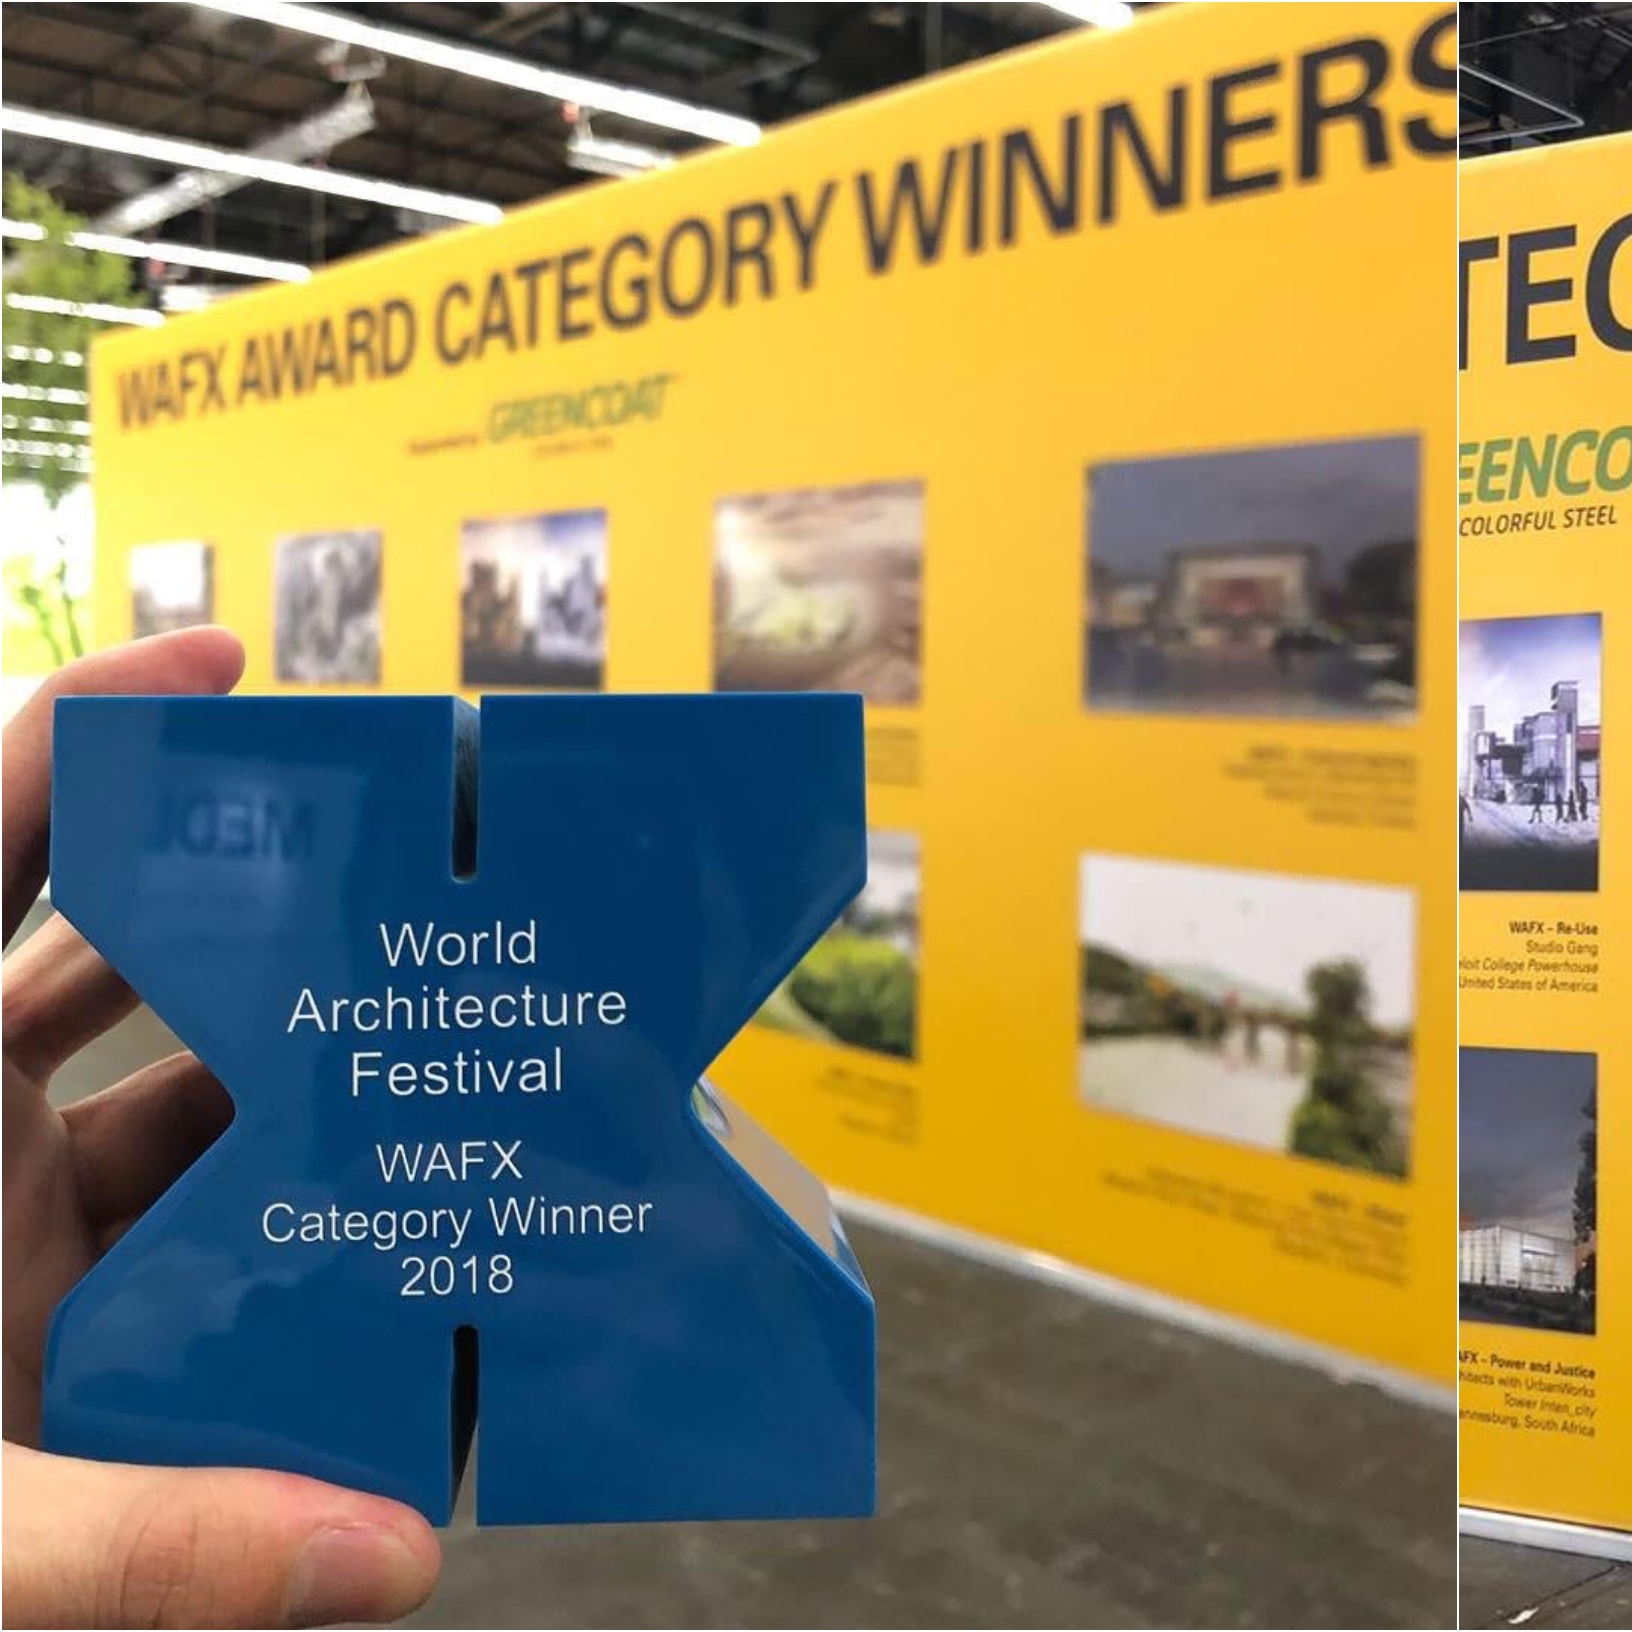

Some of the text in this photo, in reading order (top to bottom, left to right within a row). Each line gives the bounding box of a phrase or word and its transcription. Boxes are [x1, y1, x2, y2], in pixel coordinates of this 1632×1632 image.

[116, 8, 1458, 431] WAFX AWARD CATEGORY WINNERS
[1459, 504, 1617, 536] COLORFUL STEEL
[1509, 921, 1545, 934] WAFX
[1556, 922, 1598, 935] Re-Use
[380, 920, 538, 966] World
[1526, 940, 1598, 957] Studio Gang
[1482, 958, 1525, 974] College
[1527, 959, 1599, 974] Powerhouse
[1497, 976, 1533, 990] States
[1536, 977, 1548, 991] of
[1550, 979, 1598, 992] America
[287, 989, 627, 1033] Architecture
[351, 1048, 564, 1098] Festival
[376, 1141, 524, 1183] WAFX
[262, 1199, 654, 1250] Category Winner
[401, 1257, 515, 1297] 2018
[1490, 1354, 1526, 1369] Power
[1529, 1361, 1551, 1374] and
[1554, 1362, 1596, 1379] Justice
[1498, 1375, 1521, 1388] with
[1504, 1393, 1537, 1409] Tower
[1524, 1415, 1557, 1432] South
[1561, 1421, 1596, 1437] Africa
